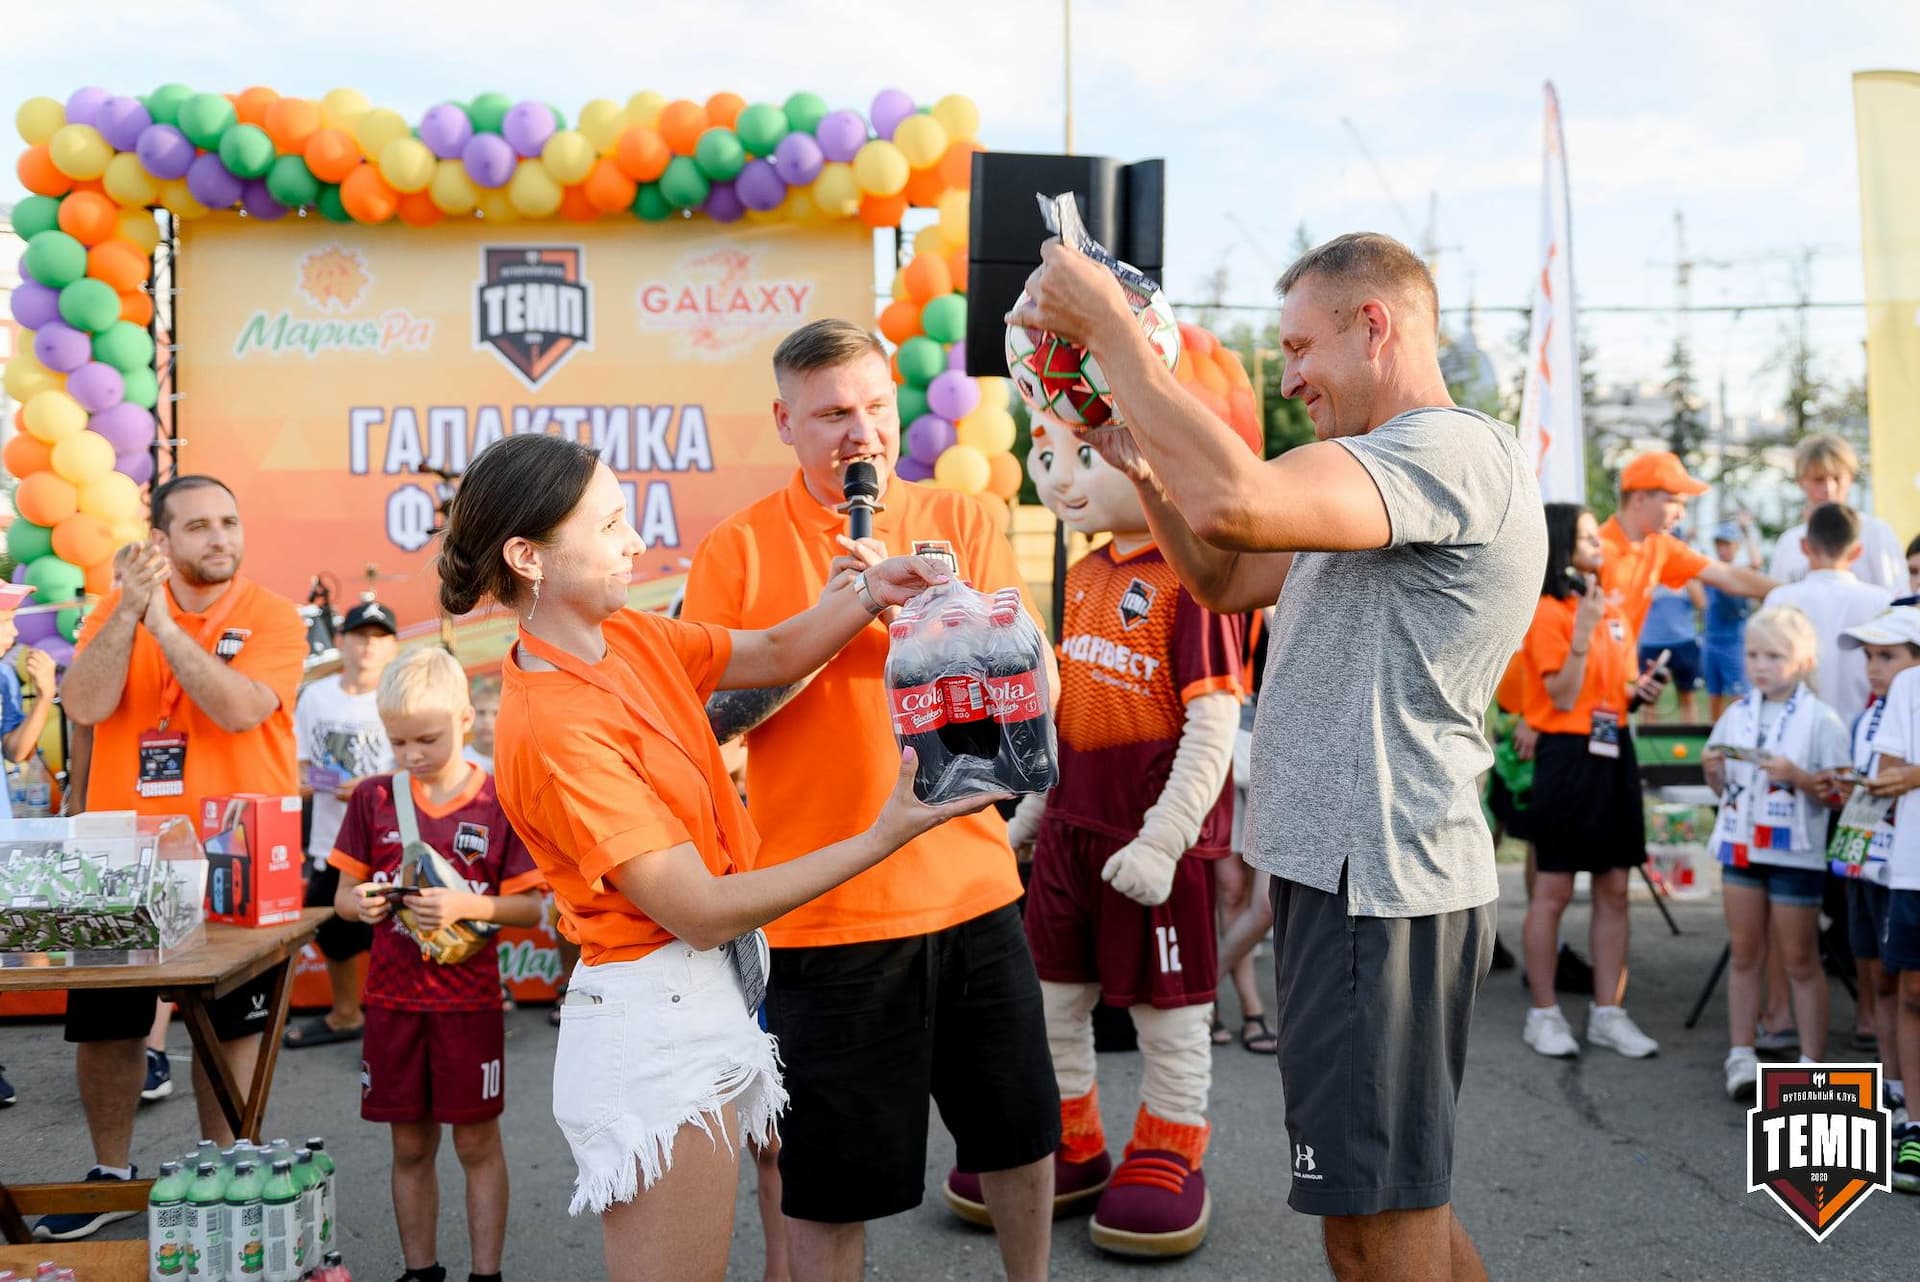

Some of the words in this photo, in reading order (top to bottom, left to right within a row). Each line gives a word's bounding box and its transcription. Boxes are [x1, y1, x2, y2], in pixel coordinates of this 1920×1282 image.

[482, 282, 584, 337] ТЕМП
[641, 285, 809, 315] GALAXY
[901, 686, 943, 711] Cola
[990, 681, 1024, 701] ola
[481, 1059, 500, 1100] 10
